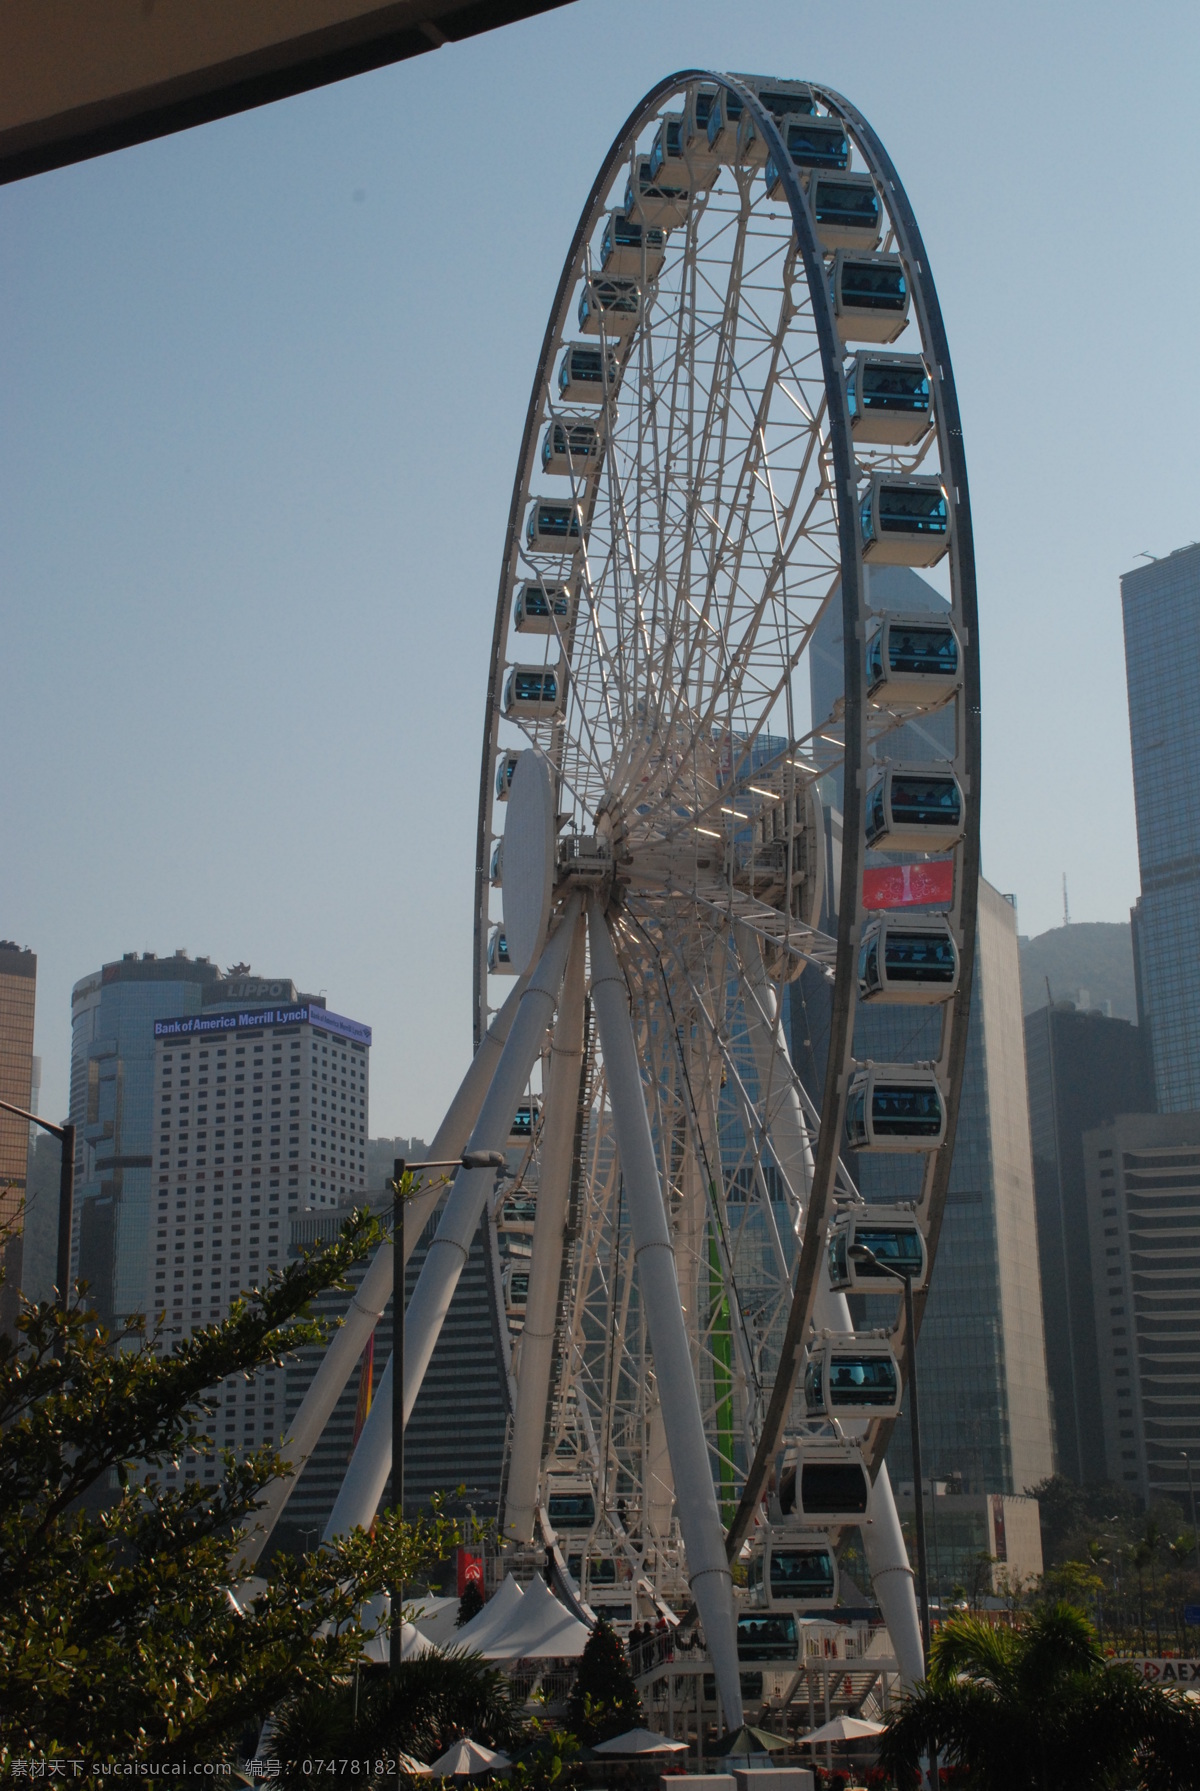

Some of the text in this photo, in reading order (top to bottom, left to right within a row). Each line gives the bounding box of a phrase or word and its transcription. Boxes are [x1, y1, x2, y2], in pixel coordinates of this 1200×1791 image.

[227, 982, 283, 998] LIPPO
[155, 1008, 308, 1034] Bank of America Merrill Lynch
